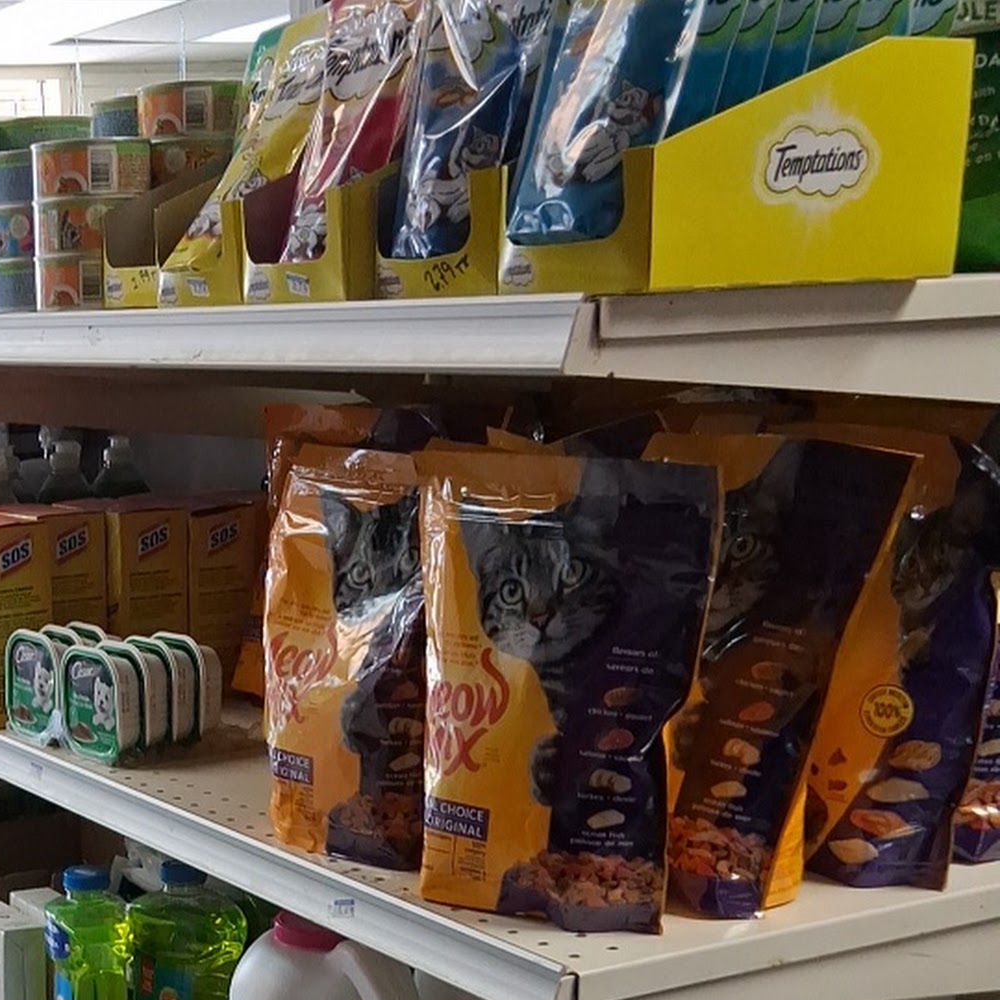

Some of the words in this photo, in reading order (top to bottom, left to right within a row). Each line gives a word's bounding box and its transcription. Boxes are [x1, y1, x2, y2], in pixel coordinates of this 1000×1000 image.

[774, 143, 865, 183] Temptations
[58, 530, 87, 557] SOS
[141, 523, 168, 551] SOS
[210, 523, 238, 550] SOS
[1, 541, 31, 570] SOS
[426, 814, 483, 838] ORIGINAL
[440, 802, 485, 823] CHOICE
